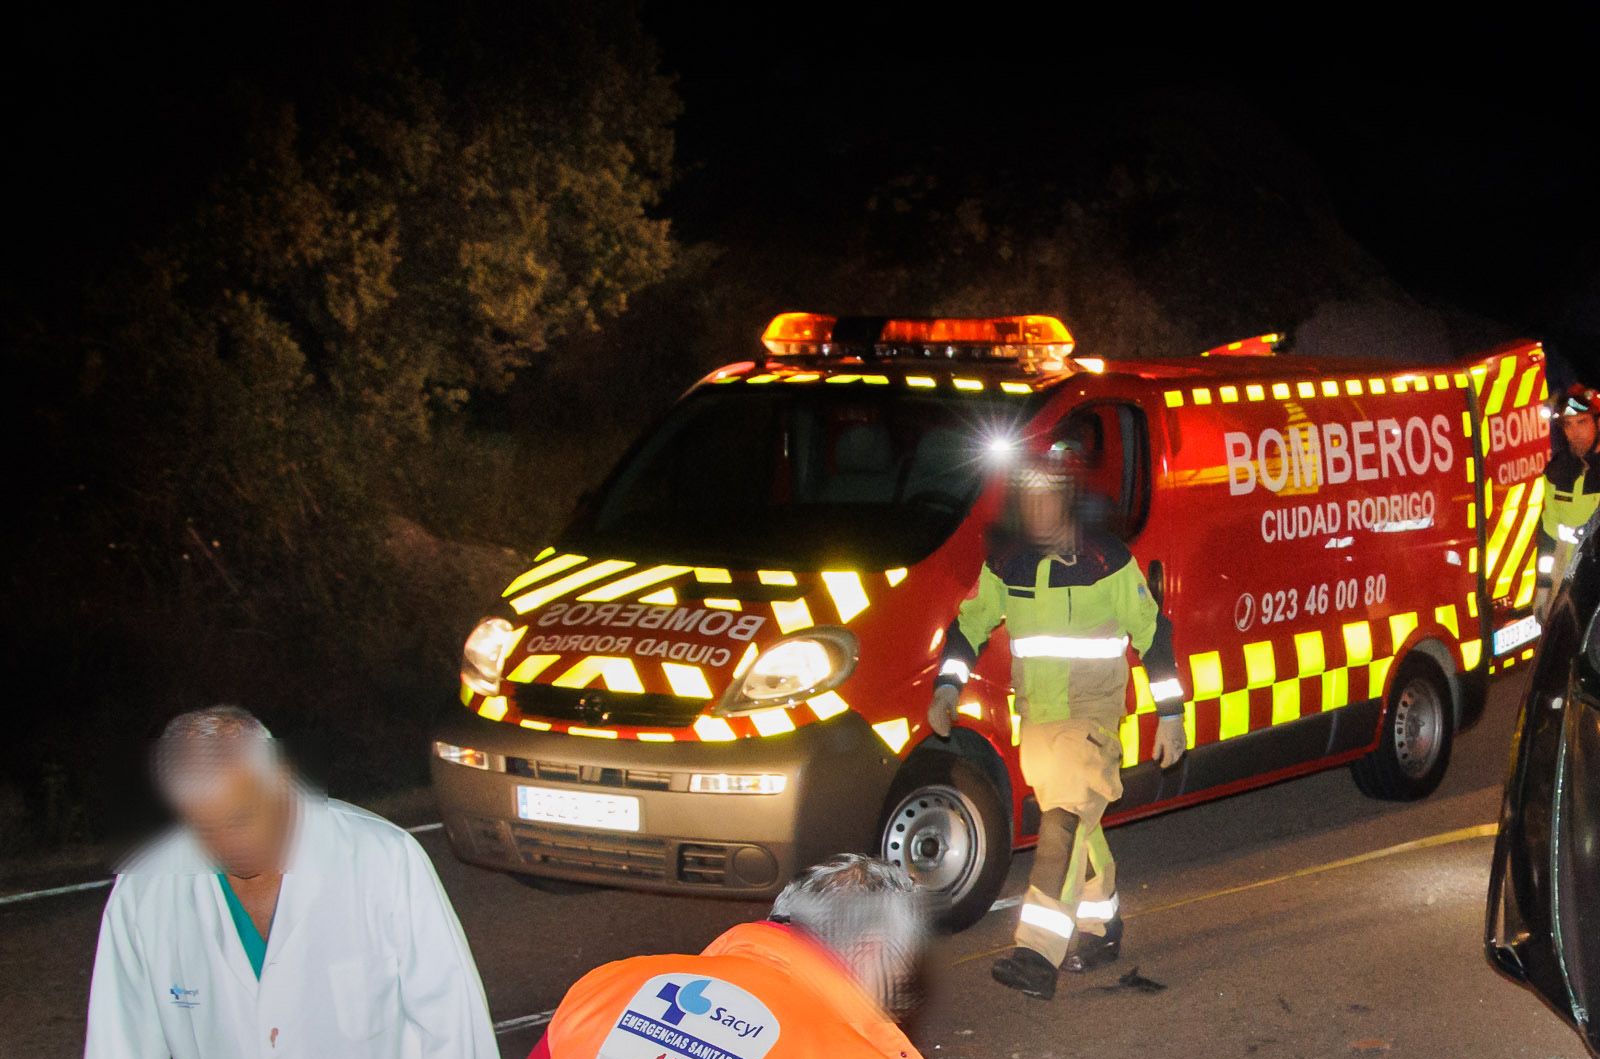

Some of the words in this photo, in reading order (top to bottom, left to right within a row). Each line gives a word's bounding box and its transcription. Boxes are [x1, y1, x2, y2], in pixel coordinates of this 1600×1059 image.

[1224, 414, 1454, 496] BOMBEROS
[1498, 452, 1546, 486] CIUDAD
[1261, 502, 1341, 543] CIUDAD
[1347, 490, 1436, 531] RODRIGO
[1261, 588, 1298, 625] 923
[1304, 583, 1329, 616] 46
[1335, 578, 1358, 611] 00
[1364, 573, 1387, 606] 80
[621, 1012, 689, 1050] EMERGENCIAS
[709, 1006, 764, 1040] Sacyl
